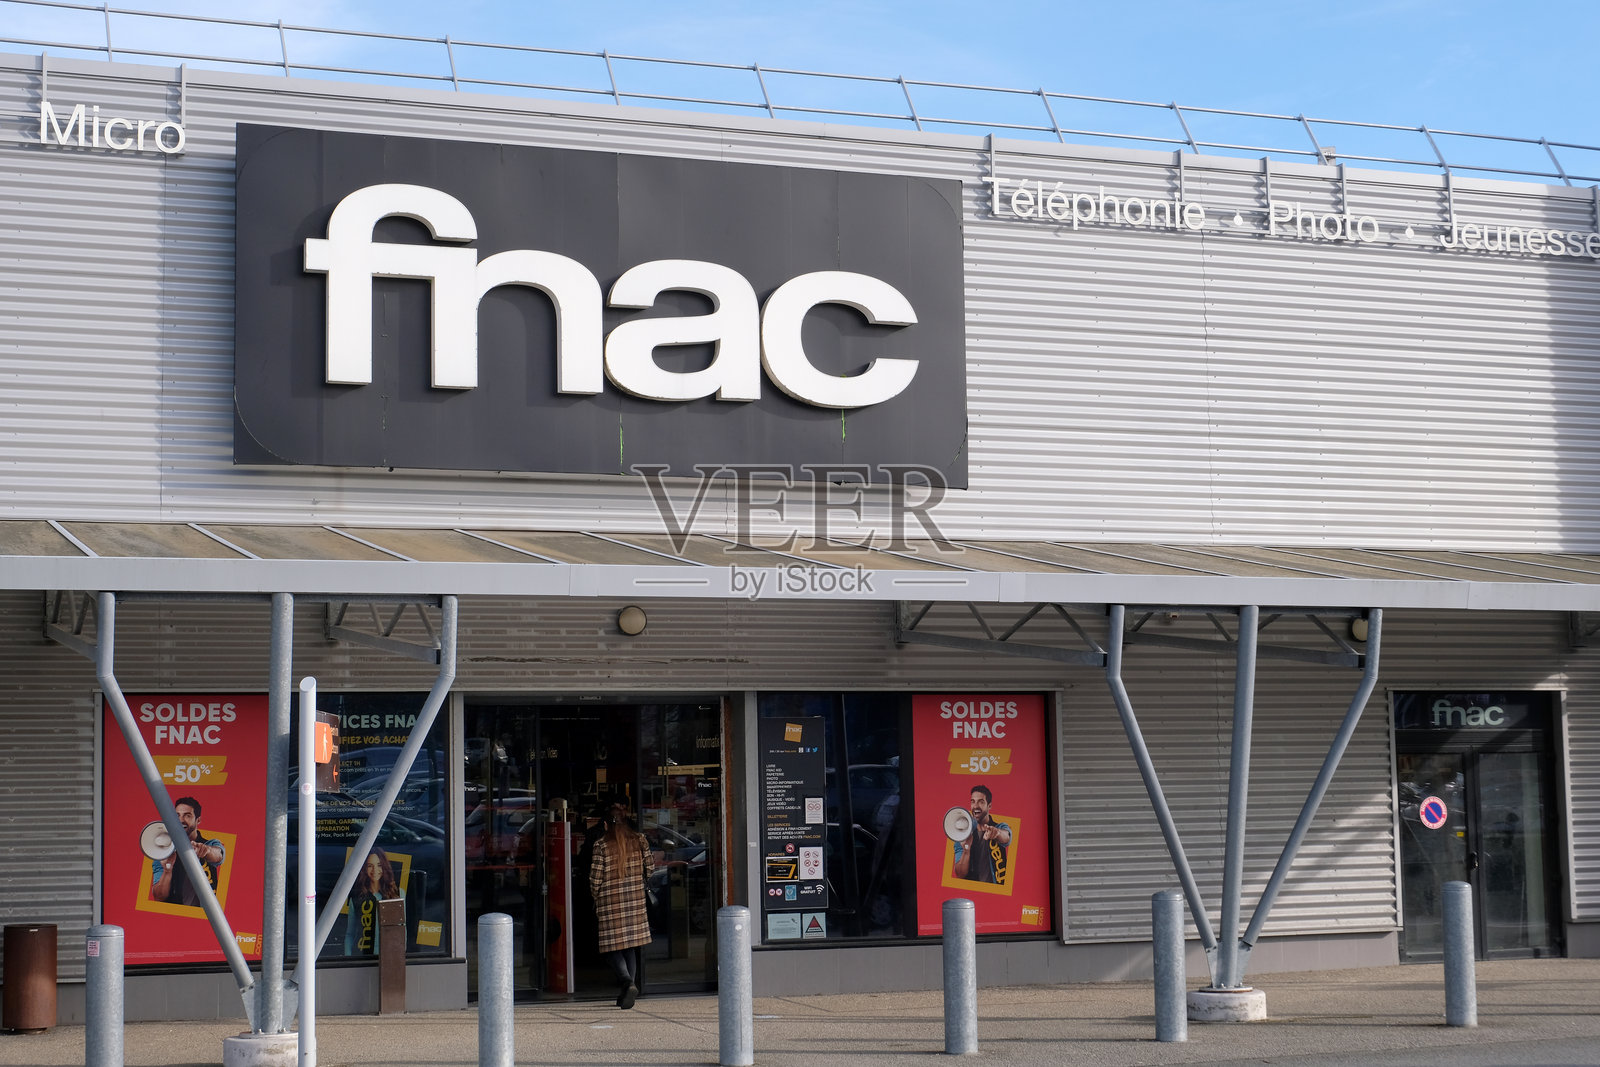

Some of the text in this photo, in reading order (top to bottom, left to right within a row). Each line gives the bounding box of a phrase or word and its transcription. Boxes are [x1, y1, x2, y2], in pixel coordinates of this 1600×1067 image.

[41, 101, 185, 153] Micro
[982, 177, 1600, 258] Téléphonie Photo Jeunesse
[304, 183, 919, 409] fnac
[139, 702, 237, 723] SOLDES
[940, 701, 1018, 719] SOLDES
[1431, 699, 1505, 726] fnac
[340, 714, 418, 729] ICES FNA
[953, 721, 1006, 738] FNAC
[155, 725, 222, 744] FNAC
[339, 735, 409, 745] IFIEZ VOS ACHA
[1022, 907, 1039, 915] fnac
[358, 899, 373, 951] fnac
[418, 924, 442, 933] fnac
